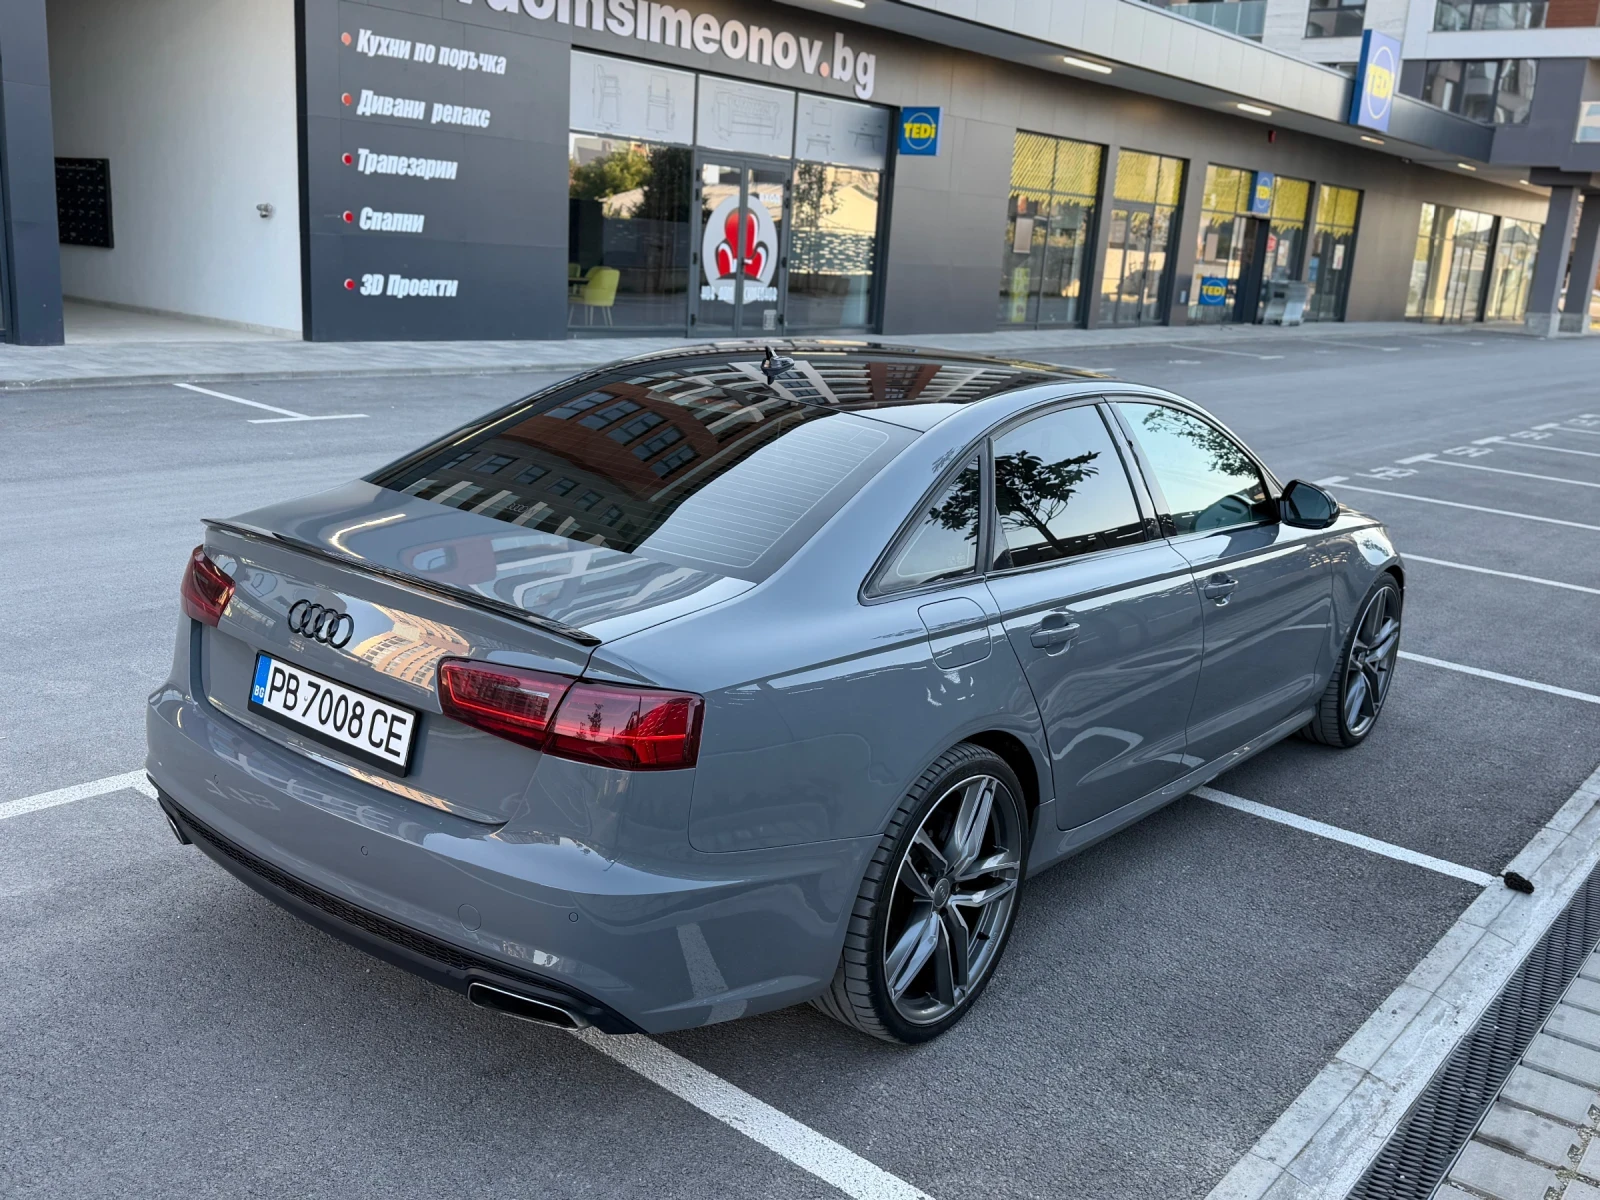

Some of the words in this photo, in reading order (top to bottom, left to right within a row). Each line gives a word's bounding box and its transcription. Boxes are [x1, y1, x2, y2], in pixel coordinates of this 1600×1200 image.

[356, 28, 411, 60] Кухни
[413, 42, 435, 63] по
[438, 46, 507, 75] поръчка
[356, 89, 426, 120] Дивани
[431, 102, 491, 128] релакс
[357, 148, 458, 180] Трапезарии
[359, 207, 425, 233] Спални
[360, 274, 383, 296] 3D
[386, 274, 459, 299] Проекти
[254, 685, 265, 699] BG
[267, 666, 300, 711] PB
[301, 681, 365, 739] 7008
[367, 708, 407, 758] CE
